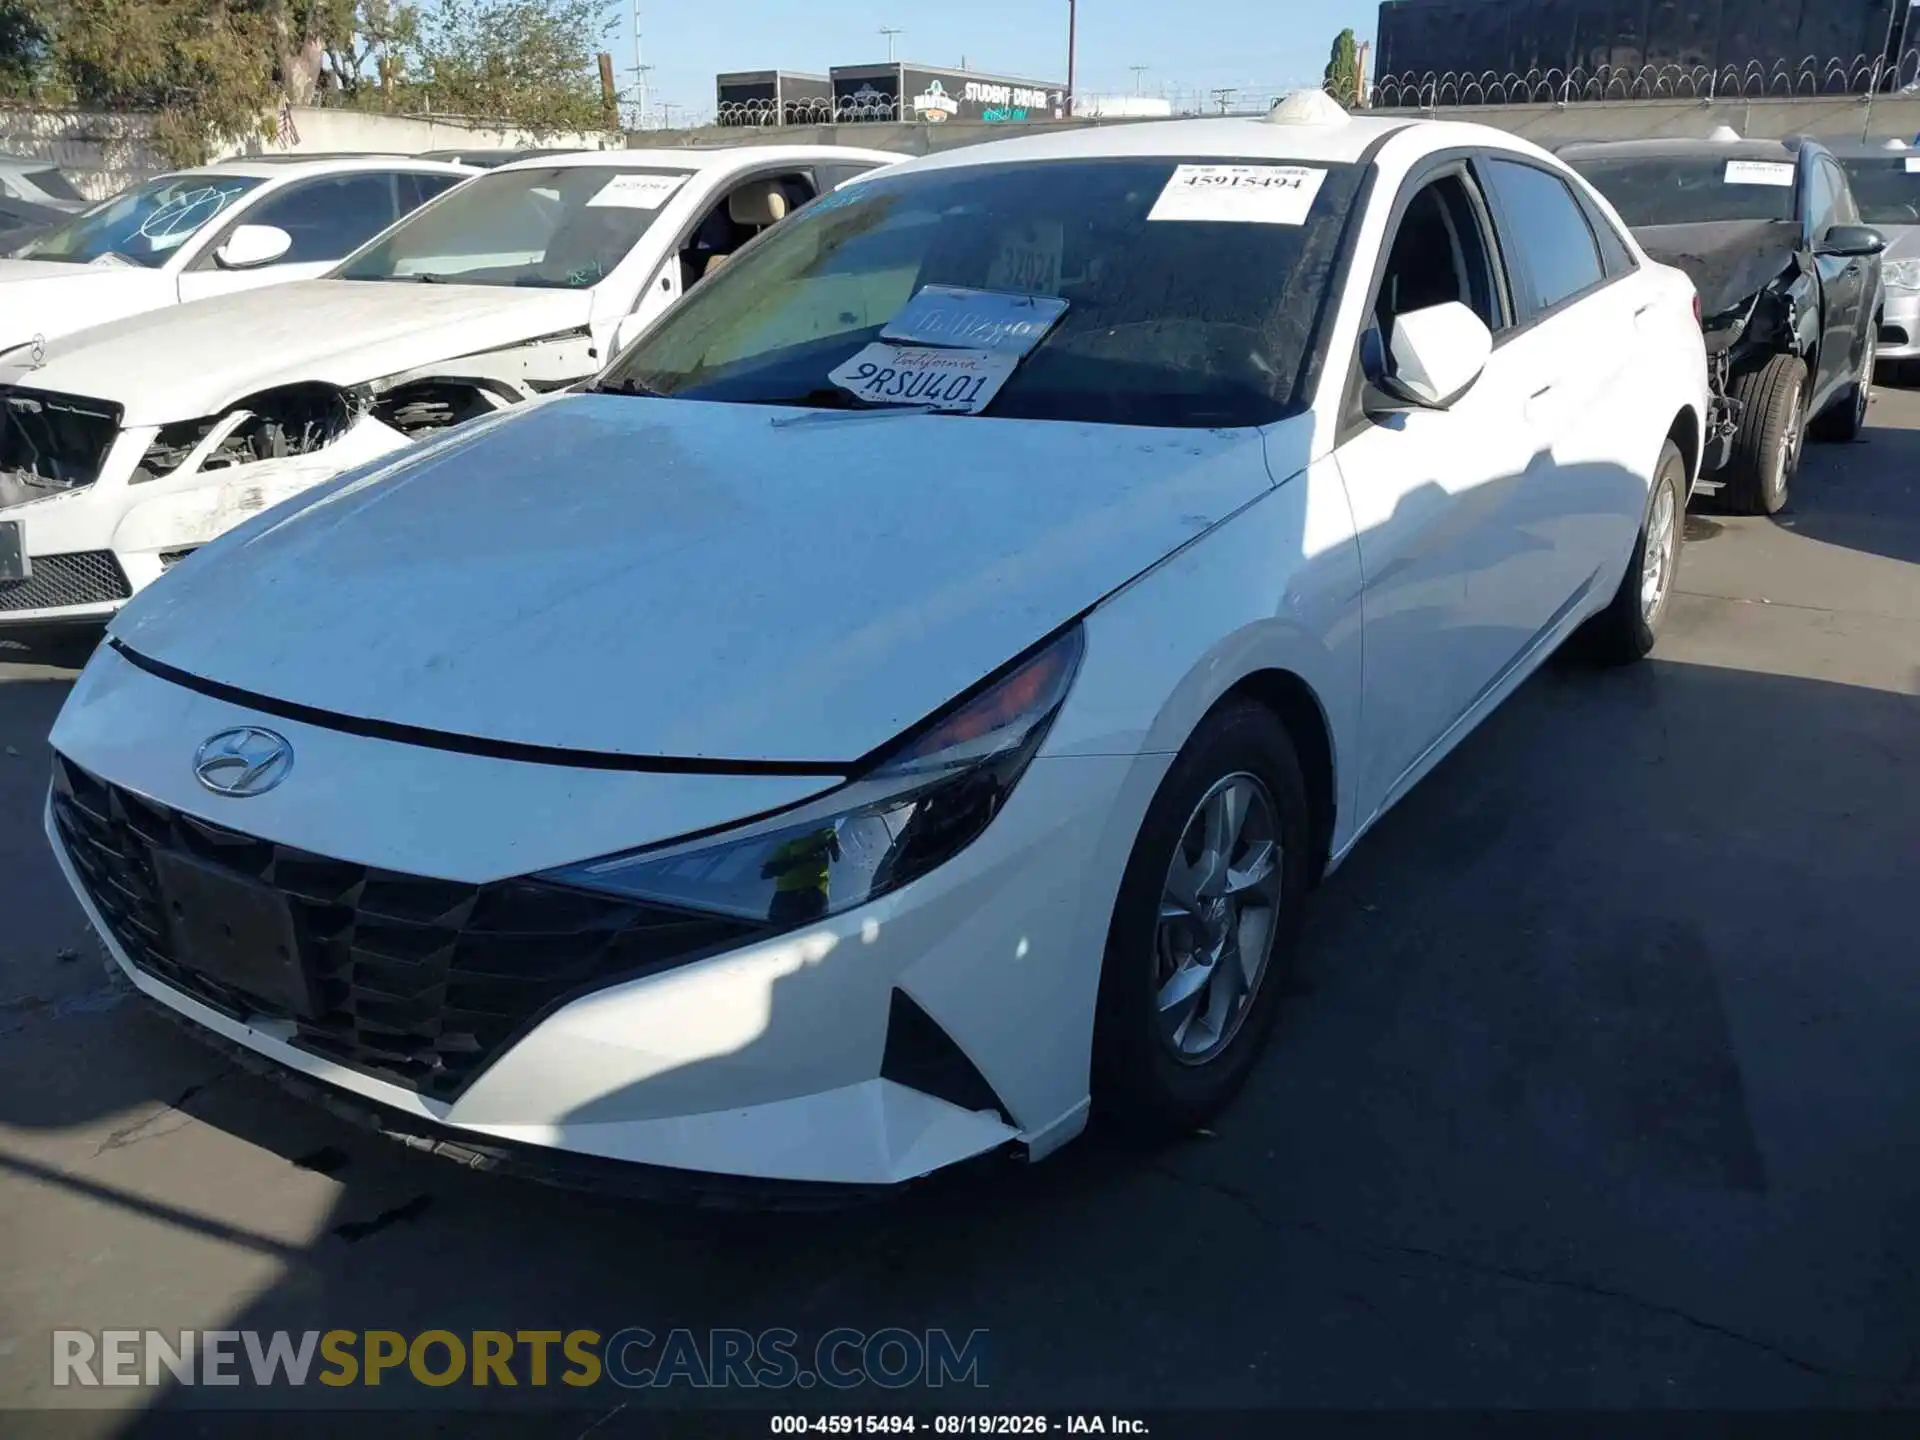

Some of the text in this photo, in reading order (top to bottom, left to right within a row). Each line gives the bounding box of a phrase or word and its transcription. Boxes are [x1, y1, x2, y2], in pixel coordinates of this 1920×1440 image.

[965, 82, 1010, 104] STUDENT
[1183, 175, 1303, 189] 45915494
[892, 350, 979, 370] California
[845, 362, 988, 402] 9RSU401
